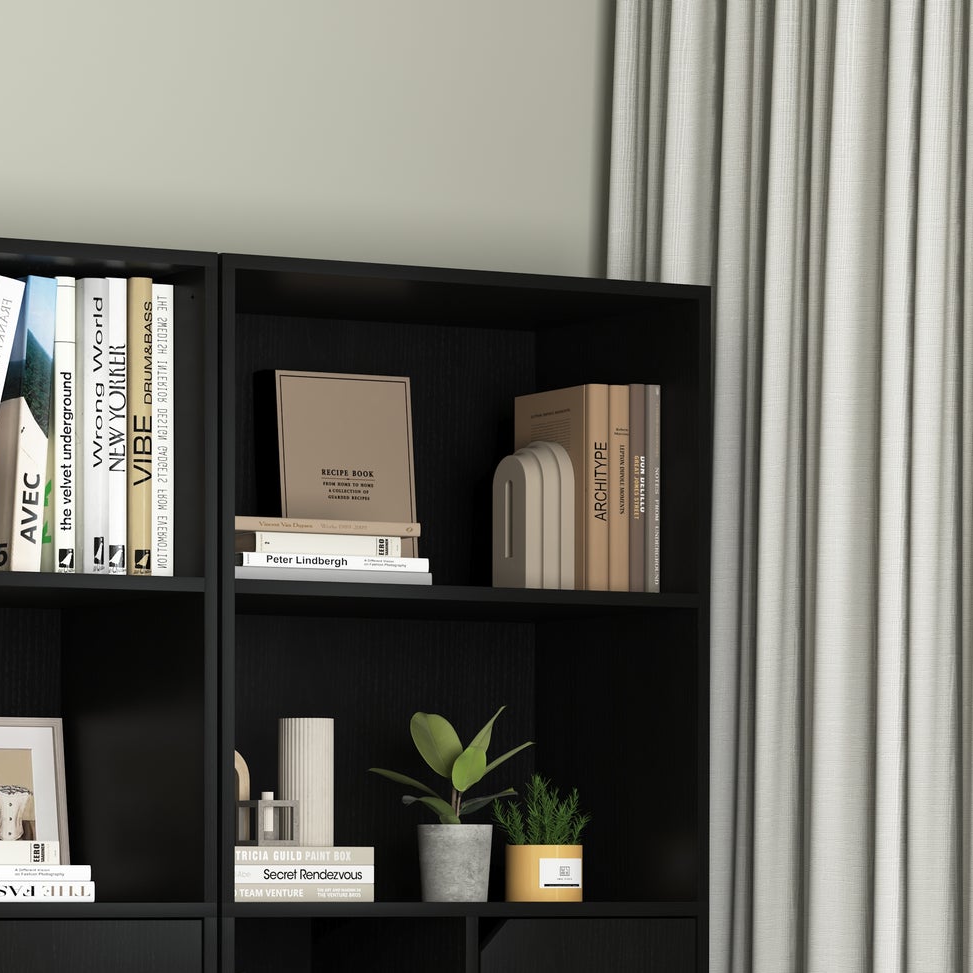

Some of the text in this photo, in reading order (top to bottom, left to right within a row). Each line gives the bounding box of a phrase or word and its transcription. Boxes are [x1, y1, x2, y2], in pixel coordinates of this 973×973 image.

[93, 297, 105, 468] Wrong World
[144, 301, 153, 404] DRUM&BASS
[108, 344, 126, 472] NEW YORKER
[60, 371, 75, 531] the velvet underground
[133, 415, 153, 486] VIBE
[321, 468, 349, 477] RECIPE
[594, 442, 607, 521] ARCHITYPE
[20, 473, 41, 544] AVEC
[266, 555, 348, 568] Peter Lindbergh
[263, 869, 363, 880] Secret Rendezvous
[273, 850, 302, 861] GUILD
[305, 851, 331, 861] PAINT
[334, 851, 352, 862] BOX
[240, 888, 263, 897] TEAM
[266, 888, 304, 897] VENTURE
